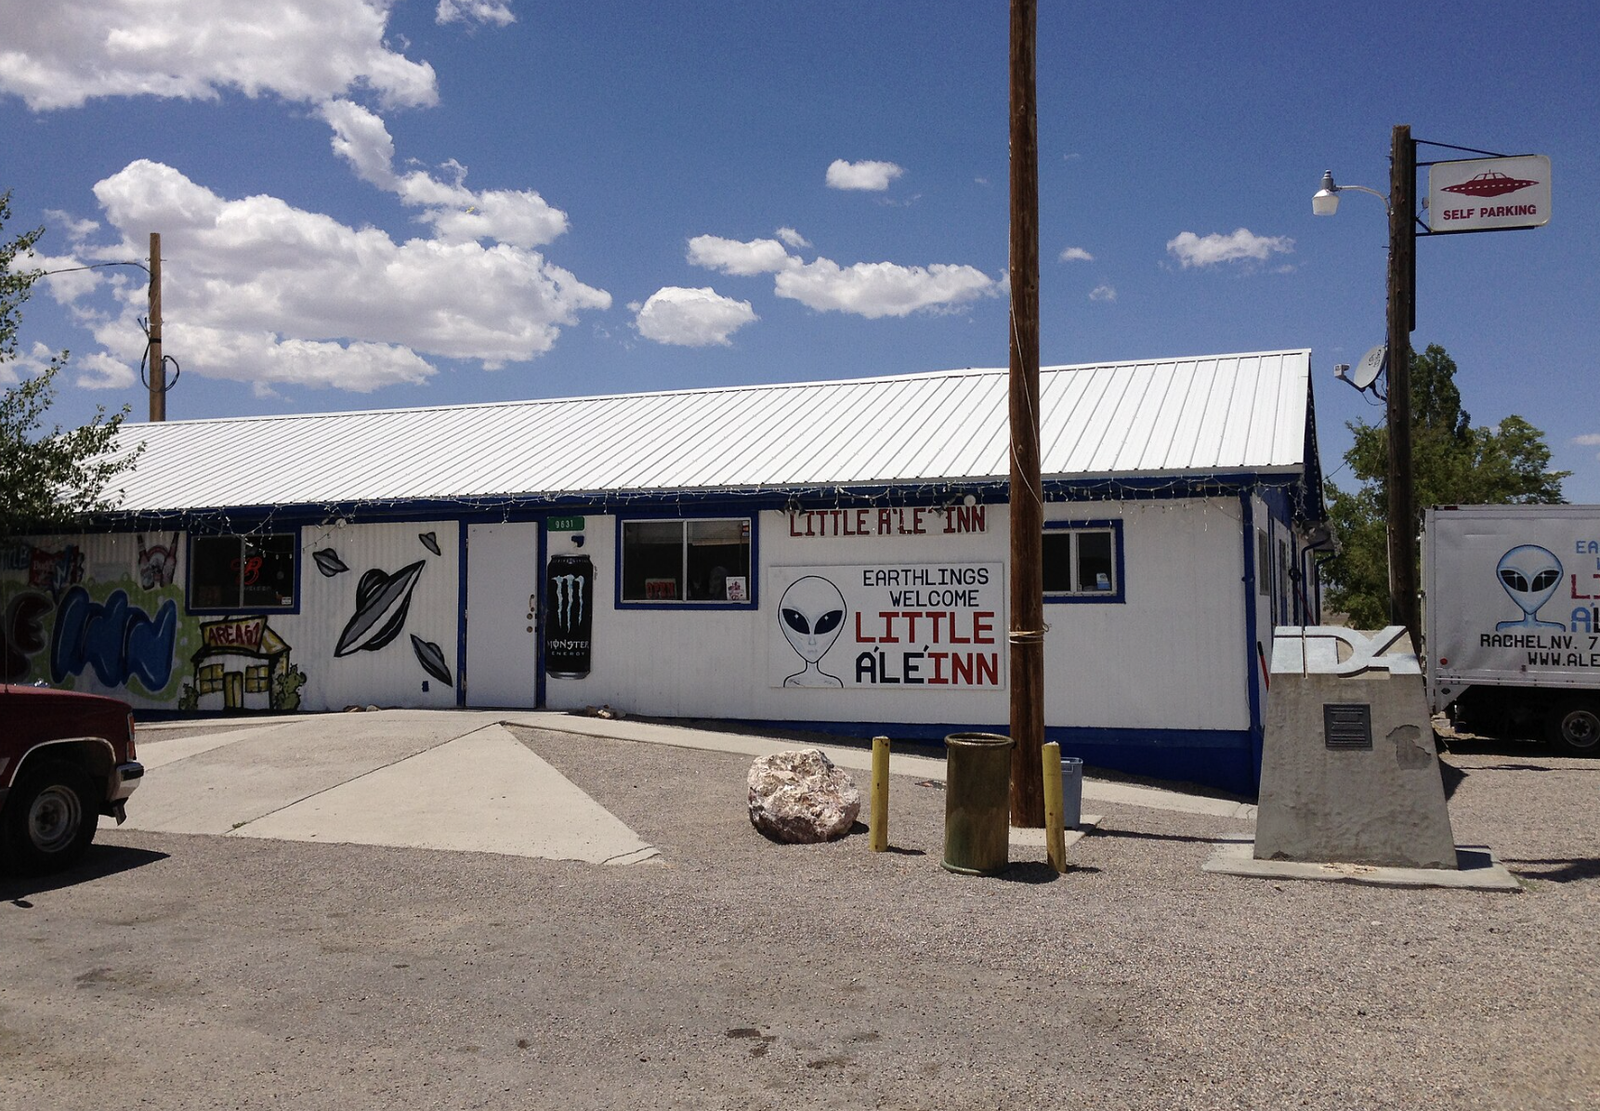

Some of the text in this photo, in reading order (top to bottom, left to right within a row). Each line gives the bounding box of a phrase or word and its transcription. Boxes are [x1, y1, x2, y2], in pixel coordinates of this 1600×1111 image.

[1443, 204, 1537, 221] SELF PARKING
[555, 520, 574, 529] 9631
[789, 509, 870, 537] LITTLE
[943, 506, 986, 534] INN
[862, 568, 990, 587] EARTHLINGS
[889, 590, 980, 608] WELCOME
[208, 622, 260, 647] AREA 51
[855, 611, 995, 644] LITTLE
[547, 639, 590, 650] MONSTER
